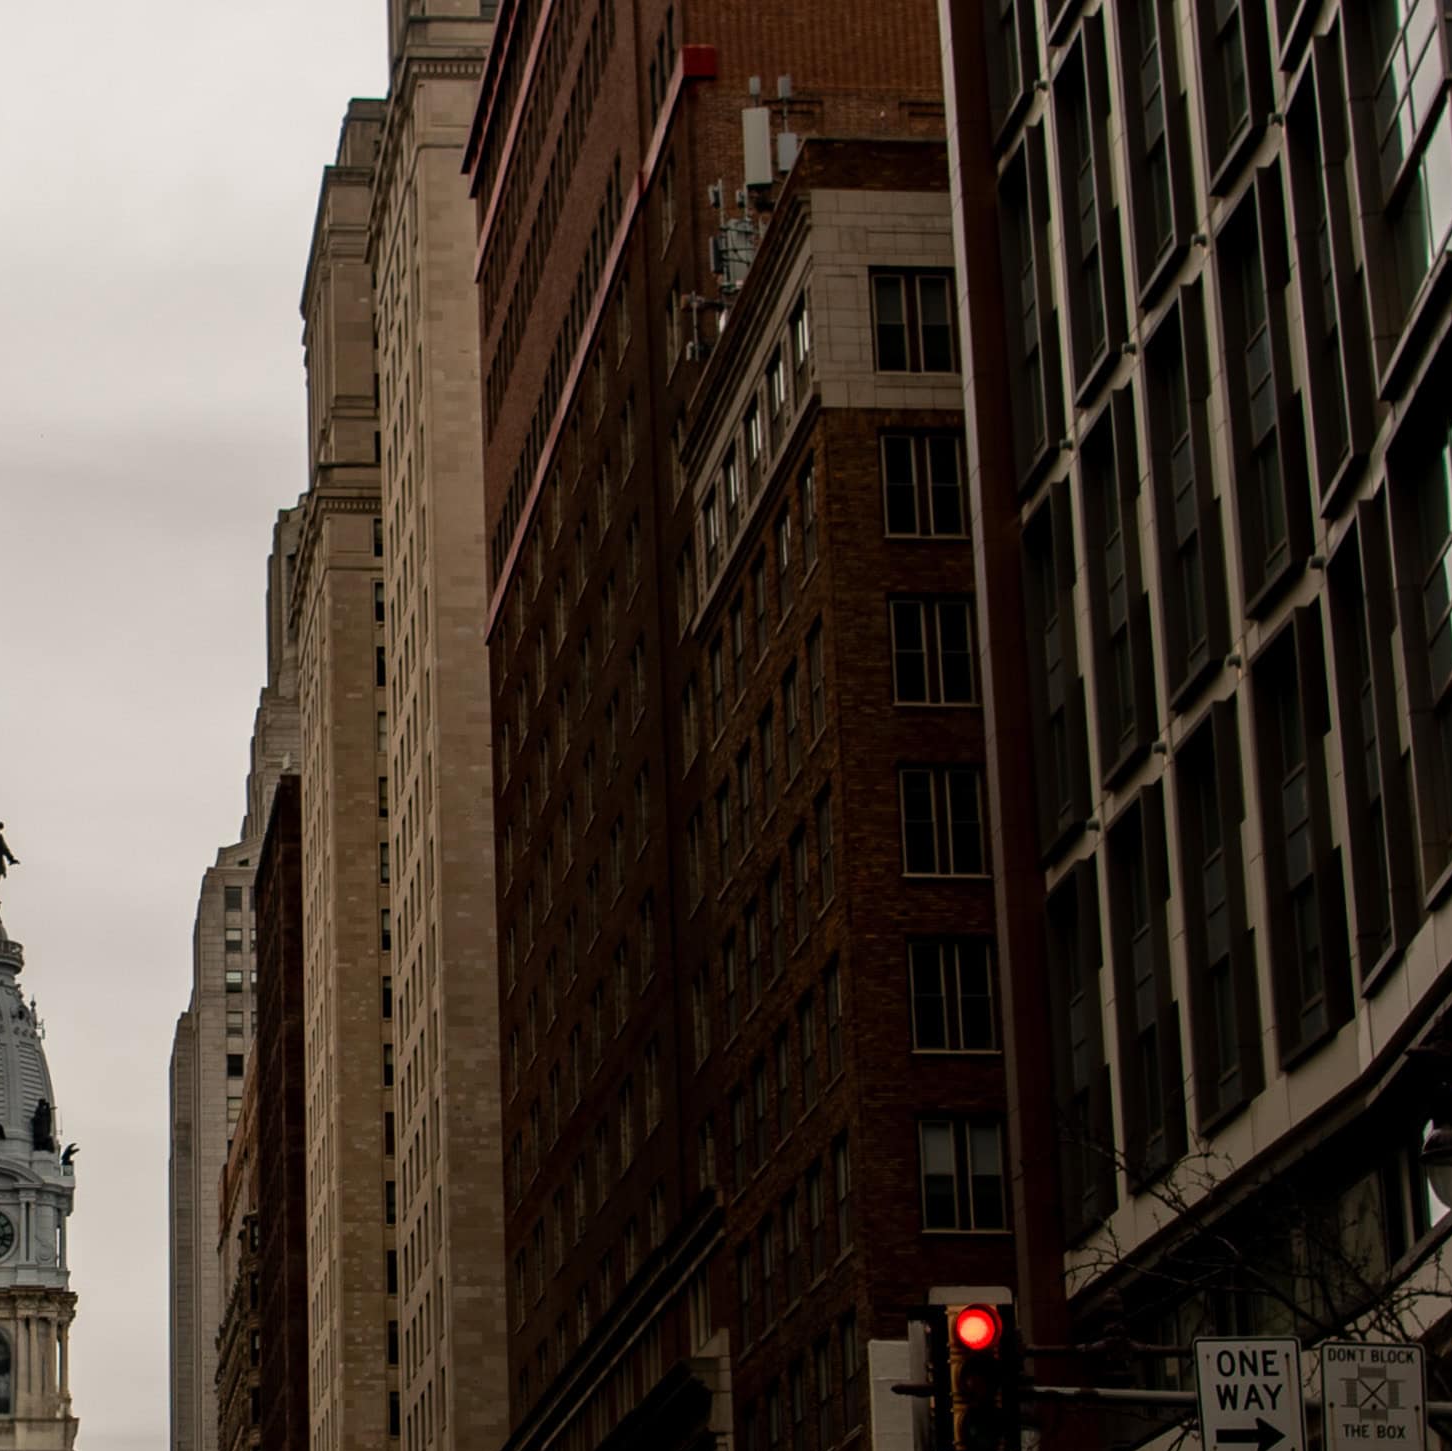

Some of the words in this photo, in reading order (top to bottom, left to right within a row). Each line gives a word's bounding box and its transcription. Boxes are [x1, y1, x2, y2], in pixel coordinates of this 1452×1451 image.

[1217, 1350, 1280, 1377] ONE
[1371, 1350, 1414, 1364] BLOCK
[1216, 1383, 1282, 1411] WAY
[1342, 1424, 1370, 1439] THE
[1376, 1424, 1406, 1439] BOX
